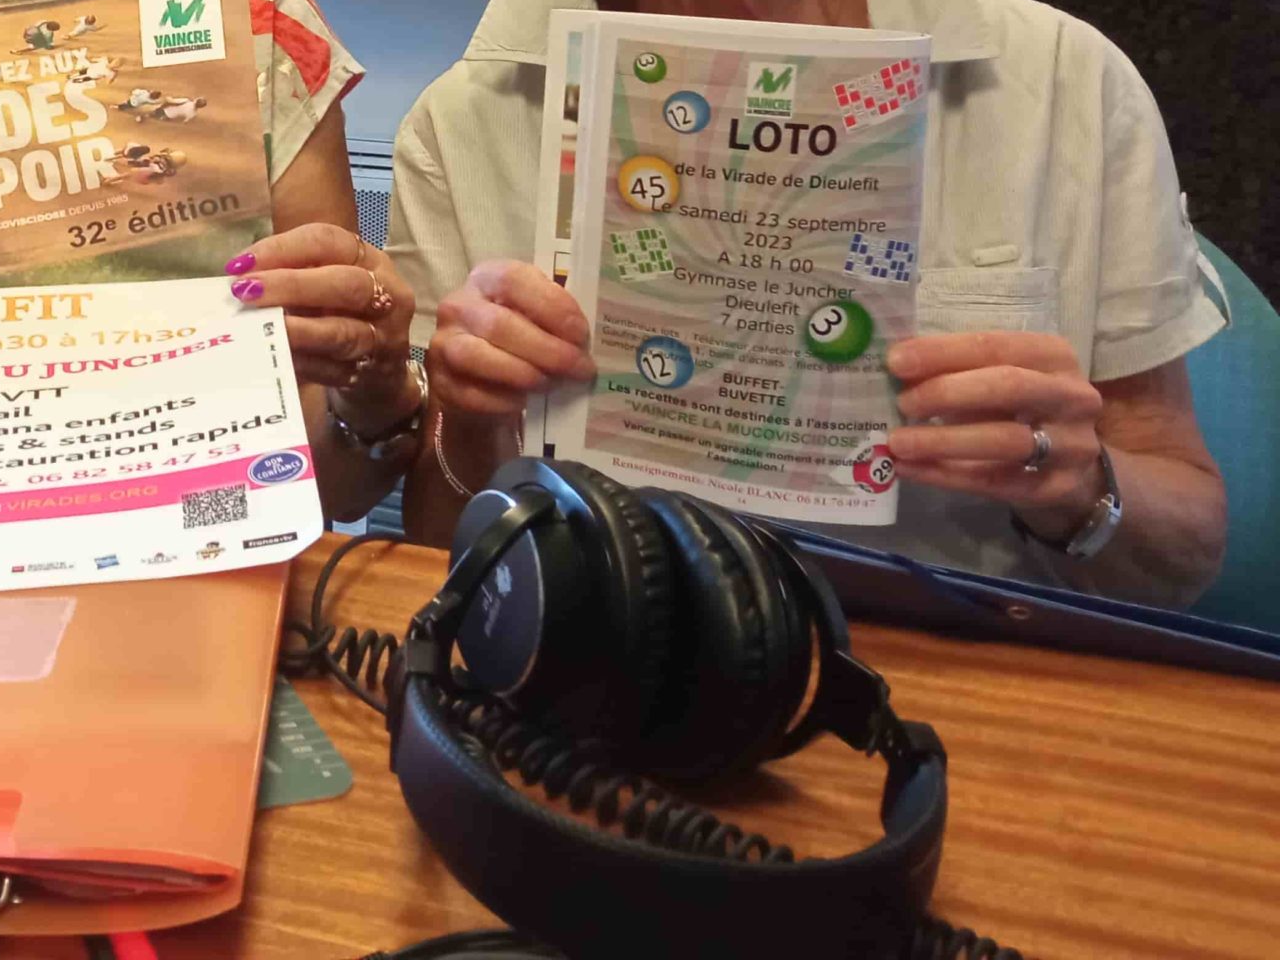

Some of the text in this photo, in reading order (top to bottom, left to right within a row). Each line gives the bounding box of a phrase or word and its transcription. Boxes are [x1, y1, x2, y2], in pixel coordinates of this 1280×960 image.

[154, 30, 212, 48] VAINCRE
[638, 55, 656, 67] 3
[747, 97, 792, 110] VAINCRE
[667, 105, 693, 128] 12
[728, 118, 837, 156] LOTO
[630, 175, 666, 200] 45
[674, 163, 880, 192] de la Virade de Dieulefit
[69, 200, 106, 216] DEPUIS
[128, 190, 240, 237] édition
[651, 195, 887, 234] Le samedi 23 septembre
[743, 232, 793, 250] 2023
[717, 251, 814, 273] A 18 00
[673, 266, 856, 300] Gymnase le Juncher
[725, 295, 801, 316] Dieulefit
[737, 317, 795, 336] parties
[811, 308, 843, 336] 3
[92, 327, 196, 346] 17h30
[40, 334, 235, 379] JUNCHER
[642, 354, 672, 380] 12
[1, 387, 68, 401] VTT
[718, 387, 786, 407] BUVETTE
[66, 396, 196, 429] enfants
[608, 382, 888, 432] Les recettes sont destinées l'association
[59, 418, 175, 446] stands
[171, 412, 284, 447] rapide
[623, 420, 811, 464] Venez passer moment
[703, 416, 859, 449] LA MUCOVISCIDOSE
[27, 473, 62, 485] 06
[72, 467, 108, 479] 82
[119, 461, 152, 474] 58
[160, 453, 196, 467] 47
[208, 443, 242, 458] 53
[257, 460, 300, 479] CONFIANCE
[264, 456, 283, 467] DON
[706, 451, 775, 472] l'association
[872, 459, 893, 482] 29
[8, 486, 158, 511] VIRADES.ORG
[708, 476, 744, 493] Nicole
[746, 486, 789, 503] BLANC
